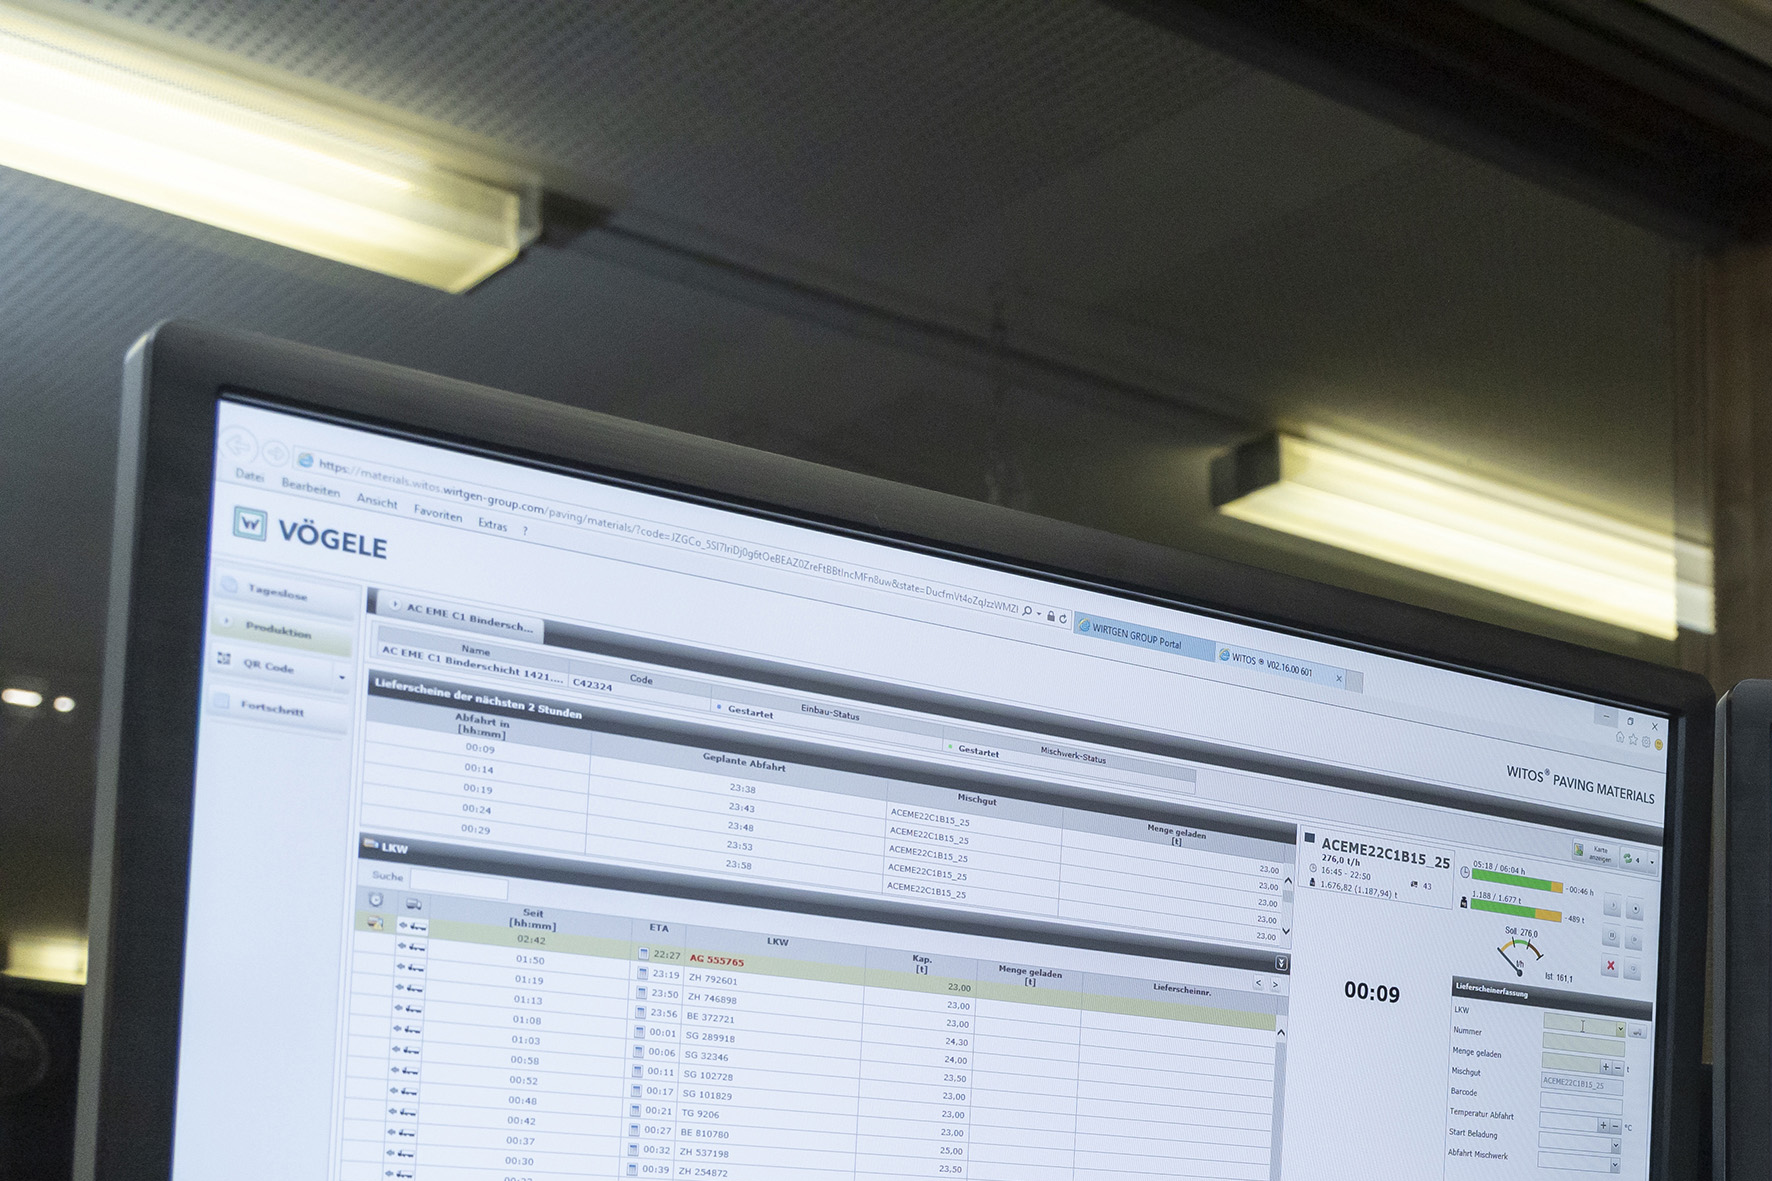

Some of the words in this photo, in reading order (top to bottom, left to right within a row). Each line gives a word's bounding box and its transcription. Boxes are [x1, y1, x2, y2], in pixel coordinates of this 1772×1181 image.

[236, 468, 265, 483] Datei
[282, 476, 341, 499] Bearbeiten
[357, 492, 398, 510] Ansicht
[414, 503, 463, 523] Favoriten
[478, 516, 508, 533] Extras
[278, 517, 388, 560] VÖGELE
[248, 583, 308, 602] Tageslose
[245, 620, 313, 642] Produktion
[1093, 623, 1128, 638] WIRTGEN
[1130, 631, 1157, 644] GROUP
[1160, 638, 1181, 649] Portal
[461, 644, 491, 657] Name
[629, 674, 653, 686] Code
[1232, 653, 1256, 665] WITOS
[243, 658, 264, 672] QR
[268, 661, 295, 676] Code
[382, 644, 397, 656] AC
[401, 647, 424, 661] EME
[428, 651, 441, 664] C1
[445, 653, 520, 678] Binderschicht
[573, 678, 613, 693] C42324
[374, 677, 450, 700] Lieferscheine
[453, 688, 472, 703] der
[475, 690, 525, 712] nächsten
[528, 703, 535, 713] 2
[538, 704, 583, 721] Stunden
[240, 700, 305, 718] Fortschritt
[728, 705, 774, 720] Gestartet
[801, 703, 860, 722] Einbau-Status
[455, 712, 496, 727] Abfahrt
[499, 719, 510, 728] in
[457, 724, 507, 741] [hh:mm]
[465, 742, 496, 755] 00:09
[959, 744, 1000, 759] Gestartet
[1040, 746, 1106, 765] Mischwerk-Status
[703, 752, 747, 769] Geplante
[750, 759, 786, 774] Abfahrt
[730, 782, 756, 795] 23:38
[1553, 774, 1594, 795] PAVING
[1597, 782, 1655, 805] MATERIALS
[957, 792, 997, 807] Mischgut
[1147, 824, 1171, 838] Menge
[1175, 830, 1207, 842] geladen
[381, 842, 409, 856] LKW
[1322, 837, 1451, 869] ACEME22C1B15_25
[1322, 854, 1344, 864] 276,0
[1347, 857, 1360, 868] t/h
[1473, 859, 1494, 870] 05:18
[1500, 864, 1519, 874] 06:04
[372, 870, 404, 882] Suche
[1321, 866, 1341, 876] 16:45
[1348, 871, 1371, 881] 22:50
[1423, 882, 1432, 890] 43
[522, 908, 544, 919] Seit
[649, 923, 669, 934] ETA
[517, 934, 546, 947] 02:42
[767, 937, 789, 948] LKW
[653, 949, 681, 961] 22:27
[690, 953, 704, 964] AG
[707, 955, 745, 968] 555765
[912, 954, 933, 966] Kap.
[1153, 982, 1212, 998] Lieferscheinnr.
[1344, 980, 1400, 1004] 00:09
[1456, 981, 1529, 999] Lieferscheinerfassung
[1454, 1005, 1469, 1015] LKW
[1453, 1026, 1482, 1036] Nummer
[1452, 1046, 1475, 1058] Menge
[1477, 1049, 1502, 1060] geladen
[1452, 1067, 1481, 1079] Mischgut
[1450, 1087, 1478, 1098] Barcode
[1450, 1107, 1488, 1119] Temperatur
[1490, 1110, 1514, 1120] Abfahrt
[1449, 1127, 1465, 1137] Start
[1467, 1129, 1498, 1141] Beladung
[1448, 1148, 1472, 1157] Abfahrt
[1474, 1150, 1508, 1161] Mischwerk
